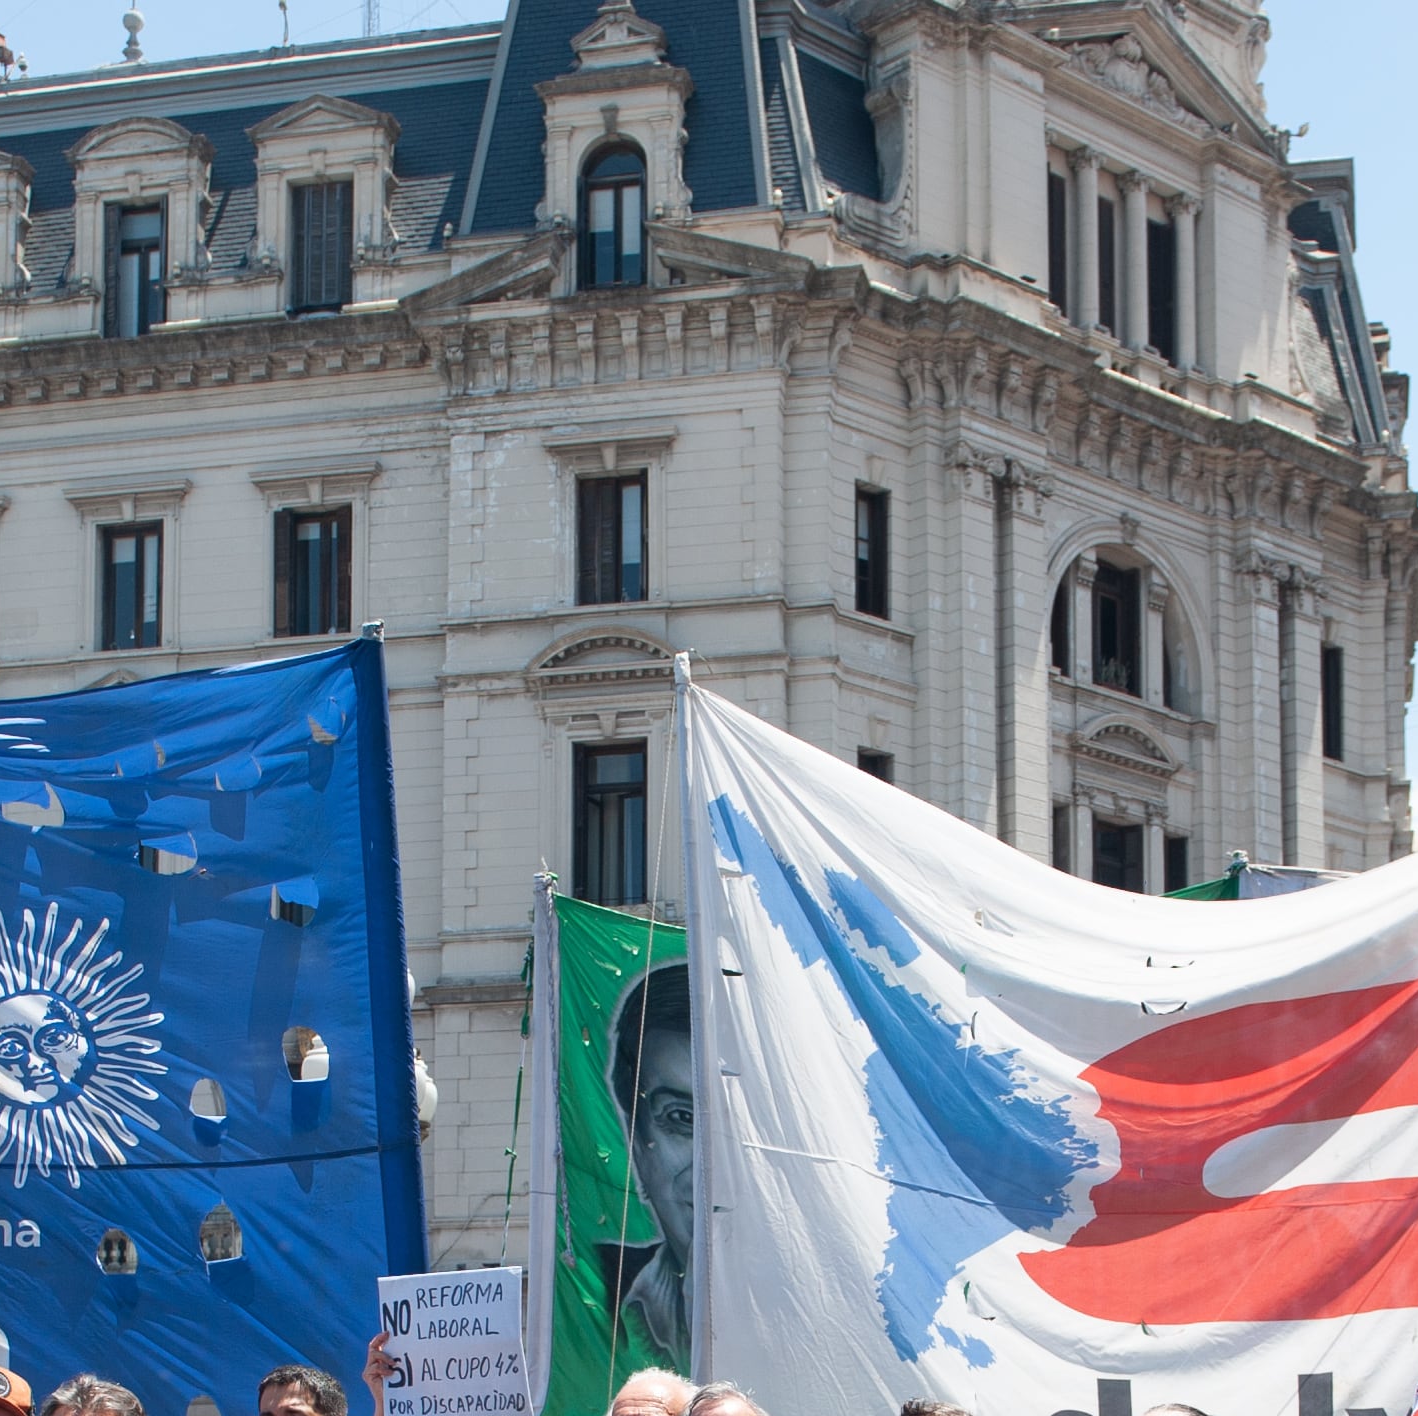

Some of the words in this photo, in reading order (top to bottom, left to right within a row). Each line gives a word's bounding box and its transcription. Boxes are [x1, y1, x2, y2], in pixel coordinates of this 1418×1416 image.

[416, 1281, 503, 1310] REFORMA
[382, 1299, 412, 1337] NO
[417, 1317, 500, 1341] LABORAL
[421, 1358, 442, 1382] AL
[445, 1356, 491, 1381] CUPO
[389, 1398, 414, 1416] POR
